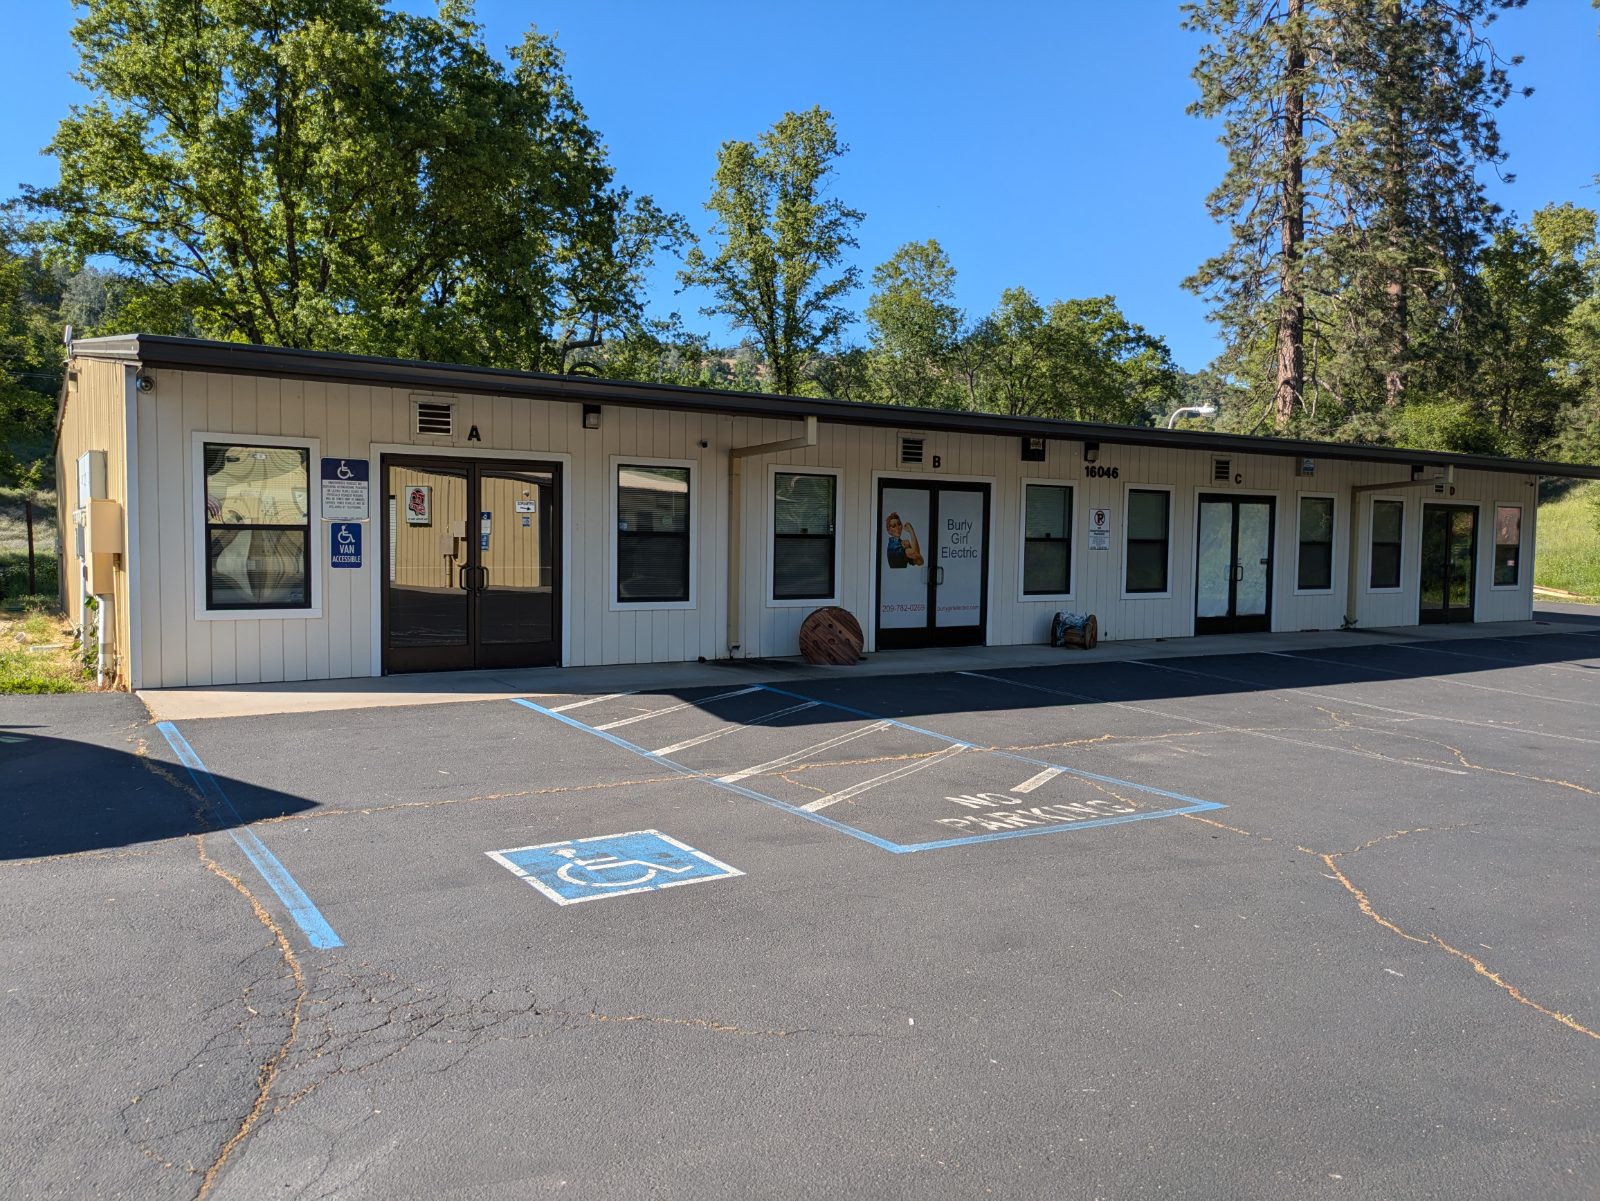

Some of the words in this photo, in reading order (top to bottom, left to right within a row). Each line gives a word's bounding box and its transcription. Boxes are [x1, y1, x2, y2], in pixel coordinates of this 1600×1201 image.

[467, 424, 482, 441] A
[932, 455, 942, 469] B
[1084, 465, 1119, 479] 16046
[1234, 473, 1243, 485] C
[947, 518, 973, 533] Burly
[951, 532, 969, 545] Girl
[339, 544, 355, 554] VAN
[941, 545, 978, 559] Electric
[332, 555, 361, 563] ACCESSIBLE
[933, 799, 1137, 835] PARKING
